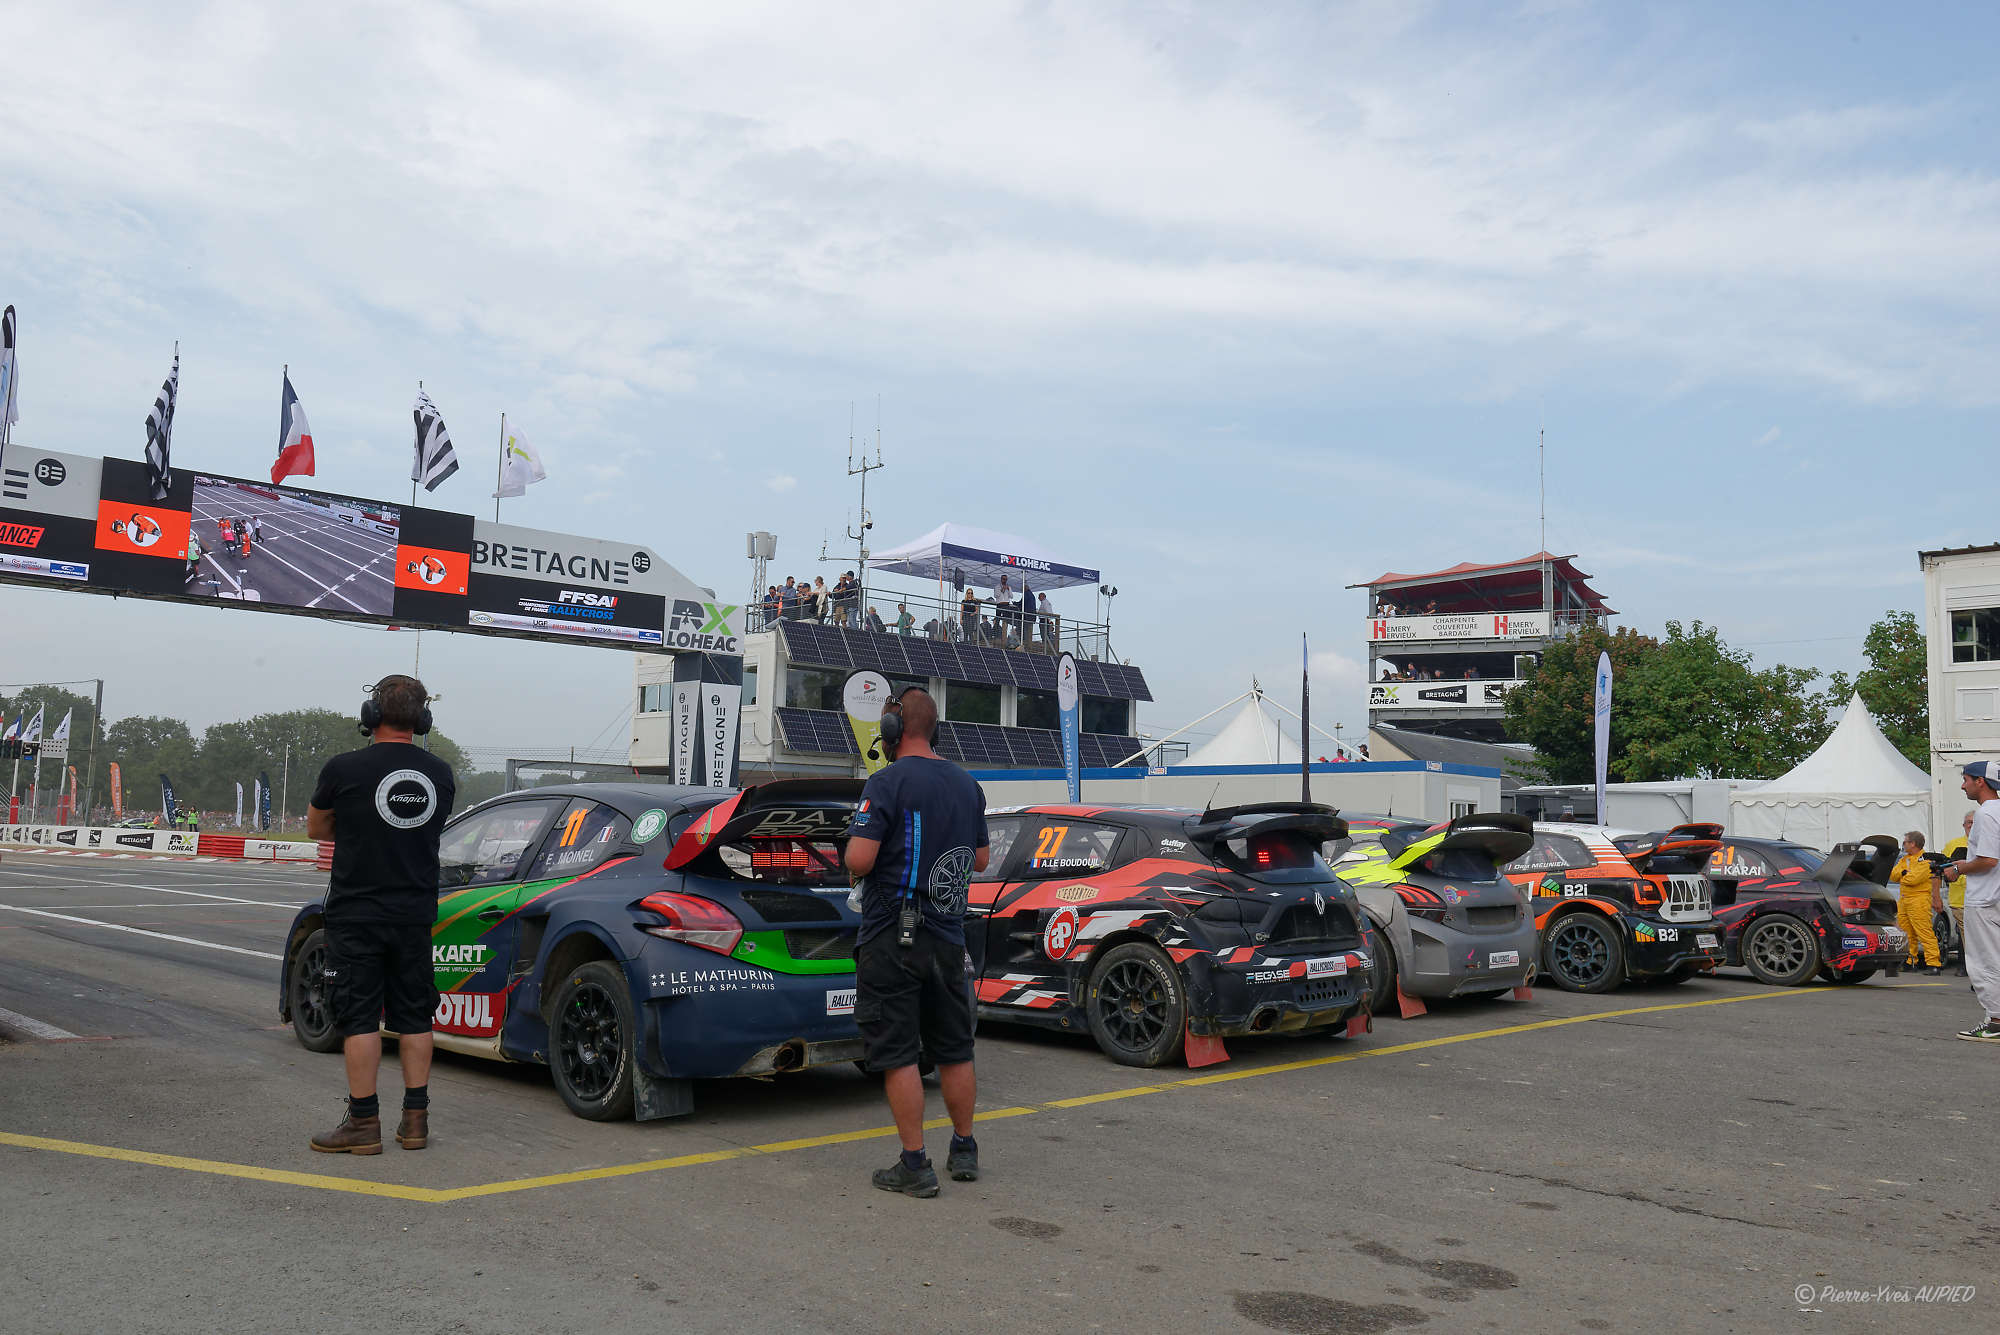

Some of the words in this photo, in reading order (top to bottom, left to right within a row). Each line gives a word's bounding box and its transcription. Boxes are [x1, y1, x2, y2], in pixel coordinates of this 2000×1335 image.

[472, 540, 629, 584] BRETAGNE
[1016, 556, 1051, 572] LOHEAC
[558, 590, 613, 608] FFSA
[548, 604, 615, 621] RALLYCROSS
[1435, 616, 1476, 624] CHARPENTE
[1433, 623, 1478, 631] COUVERTURE
[667, 632, 738, 653] LOHEAC
[1425, 691, 1459, 699] BRETAGNE
[680, 704, 689, 786] BRETAGNE
[713, 706, 726, 788] BRETAGNE
[559, 808, 589, 848] 11
[1034, 826, 1069, 859] 27
[557, 849, 595, 865] MOINEL
[1711, 845, 1735, 865] 51
[1564, 883, 1588, 897] B2i
[1657, 928, 1679, 942] B2i
[671, 971, 688, 984] LE
[695, 969, 774, 983] MATHURIN
[671, 985, 705, 995] HÔTEL
[709, 984, 716, 992] &
[720, 983, 738, 991] SPA
[751, 983, 776, 991] PARIS
[432, 993, 494, 1028] OTUL
